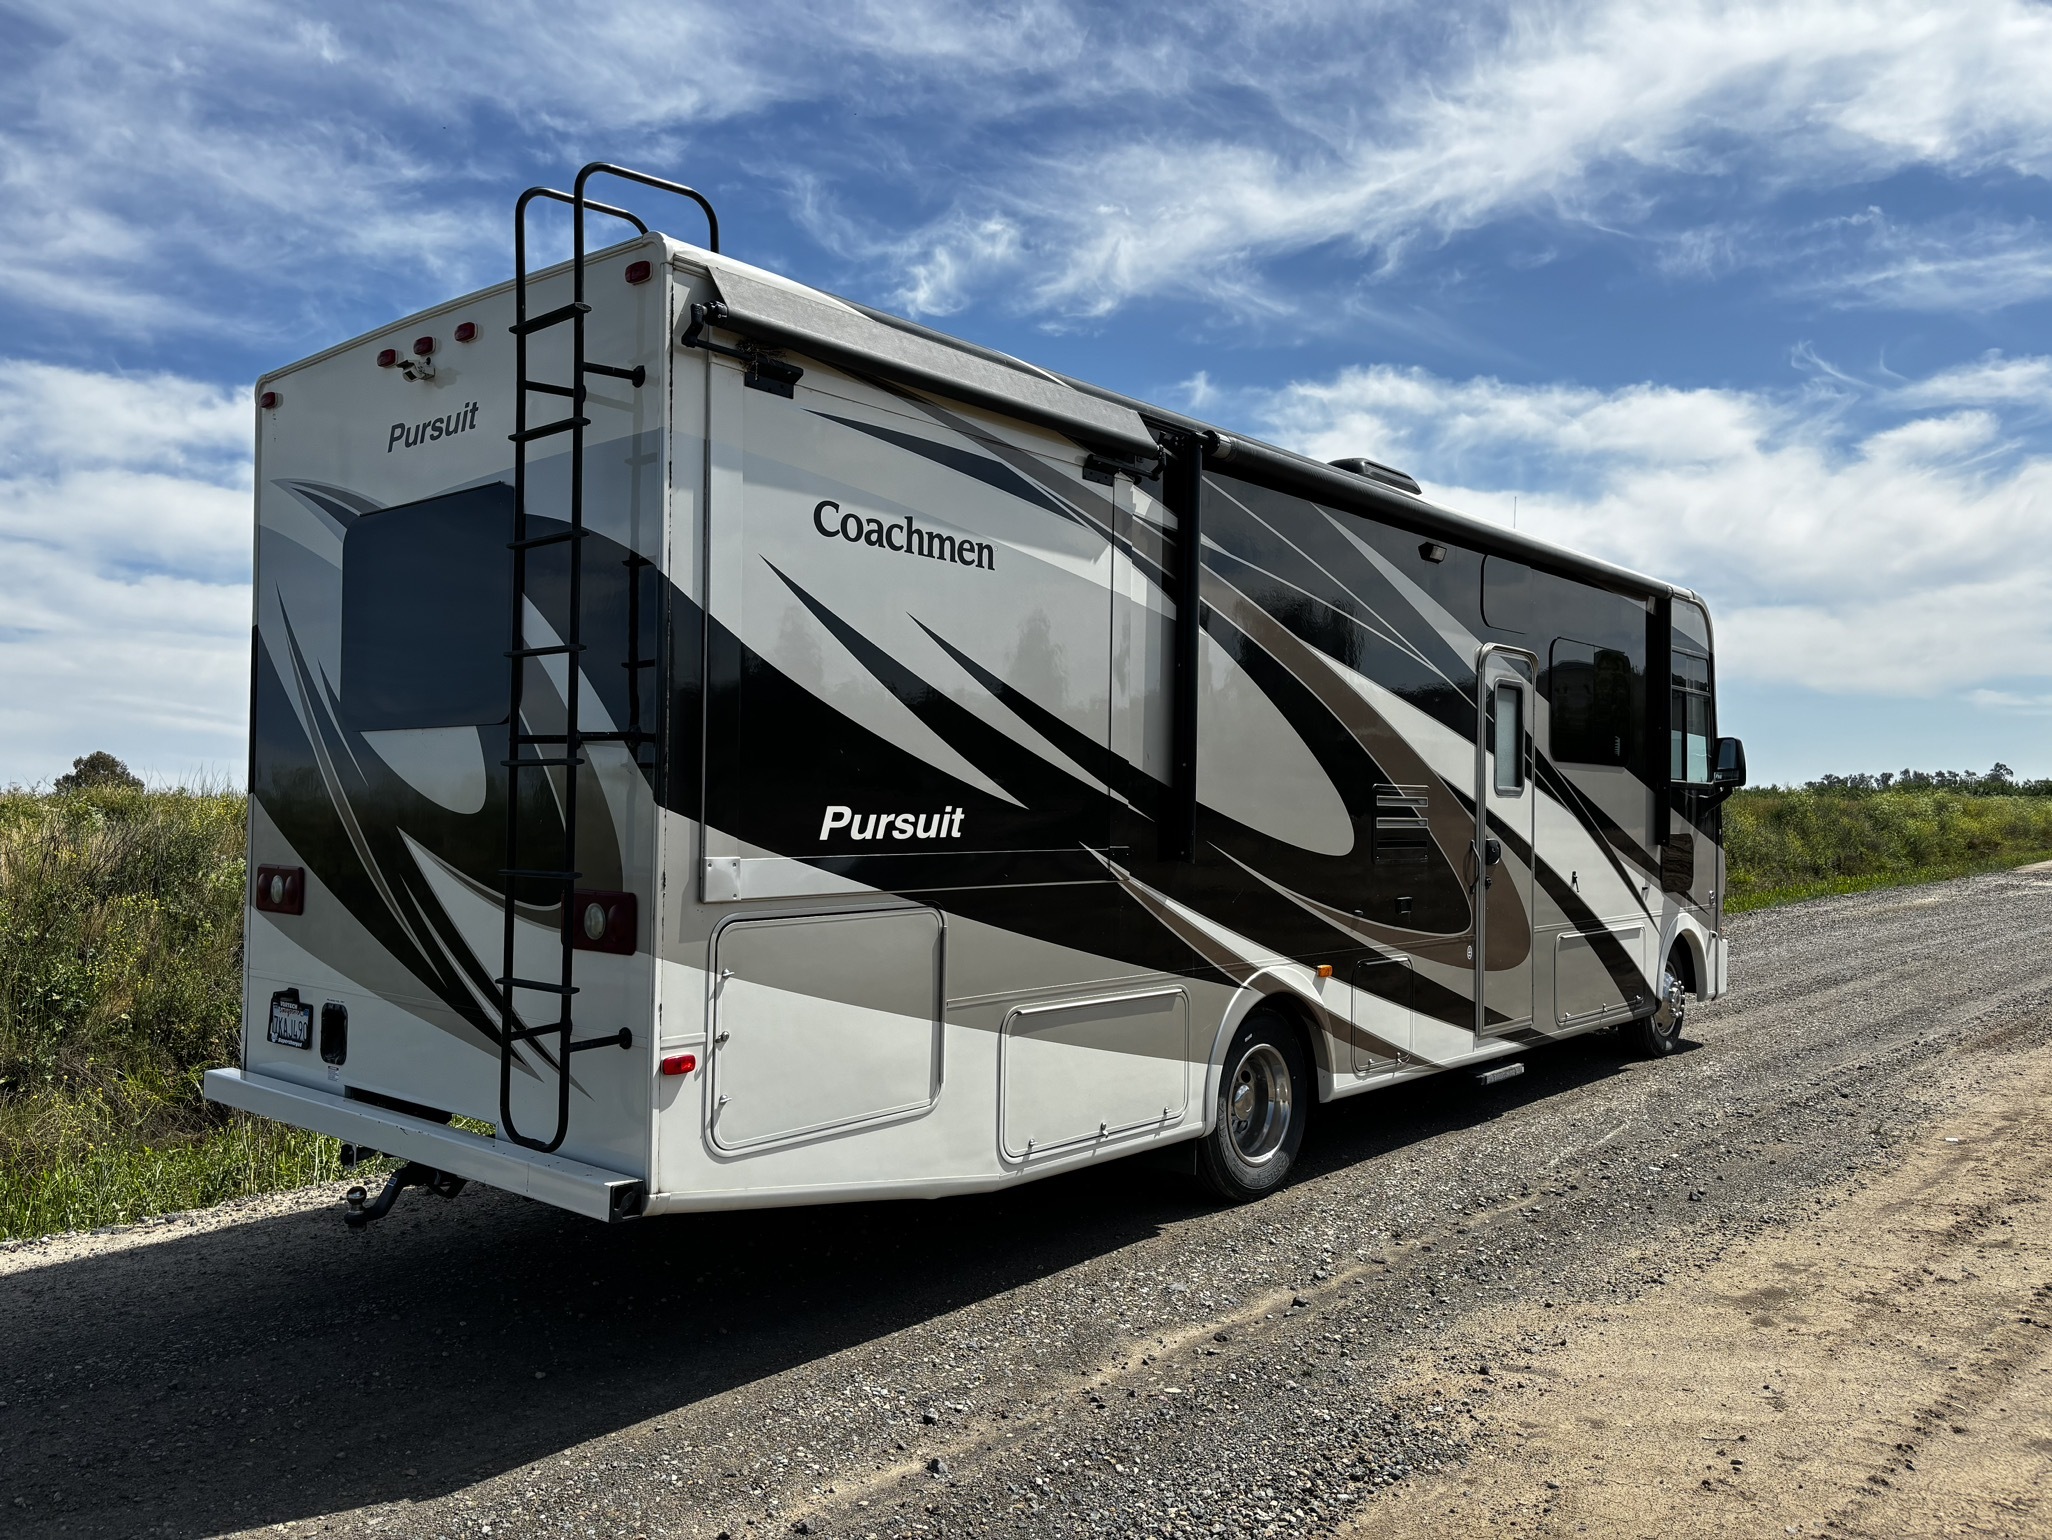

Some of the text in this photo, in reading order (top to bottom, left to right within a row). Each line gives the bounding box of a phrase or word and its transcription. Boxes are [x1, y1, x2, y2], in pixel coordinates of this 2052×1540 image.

[387, 401, 479, 453] Pursuit
[813, 500, 995, 571] Coachmen
[819, 805, 965, 841] Pursuit
